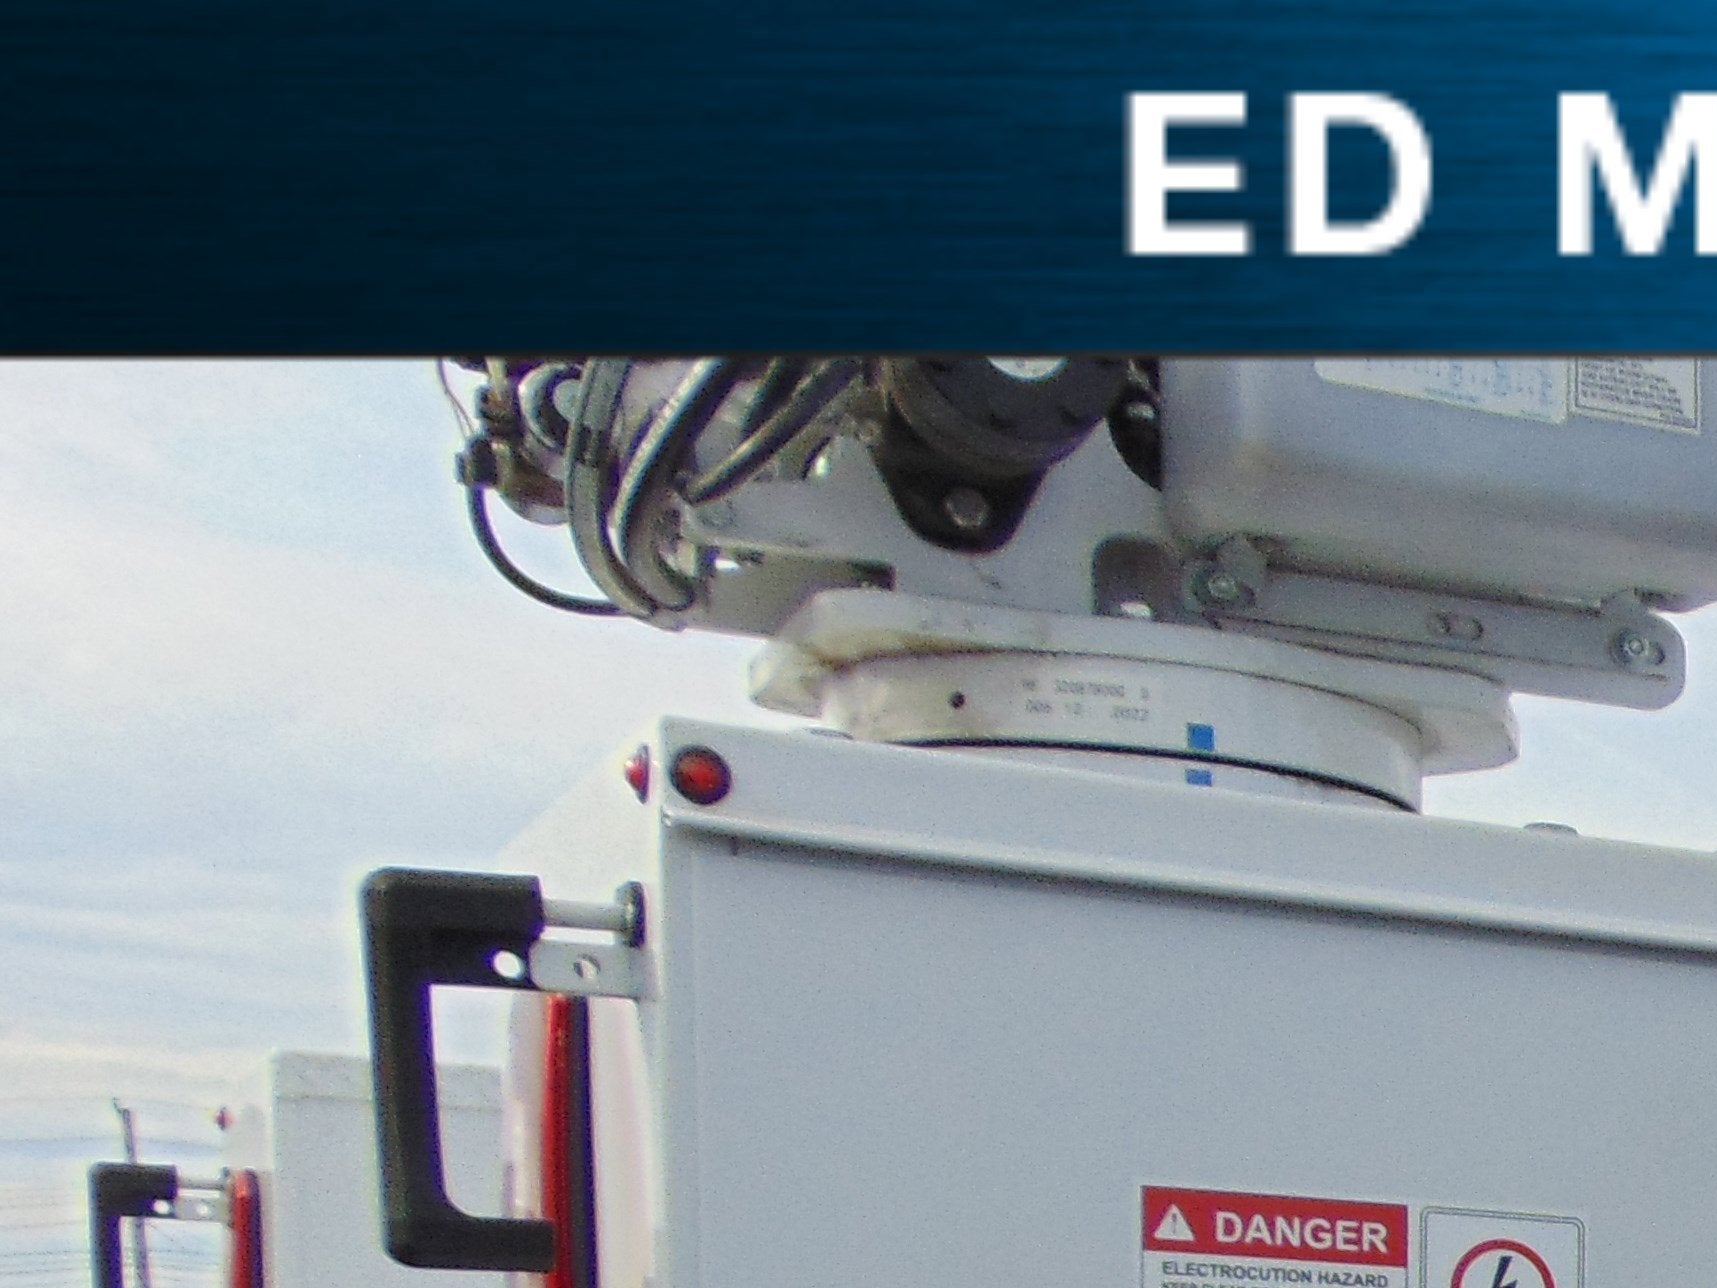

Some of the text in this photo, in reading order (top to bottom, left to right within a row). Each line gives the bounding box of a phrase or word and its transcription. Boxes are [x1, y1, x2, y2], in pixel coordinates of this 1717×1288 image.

[1214, 1210, 1389, 1254] DANGER
[1161, 1260, 1388, 1288] ELECTROCUTION HAZARD
